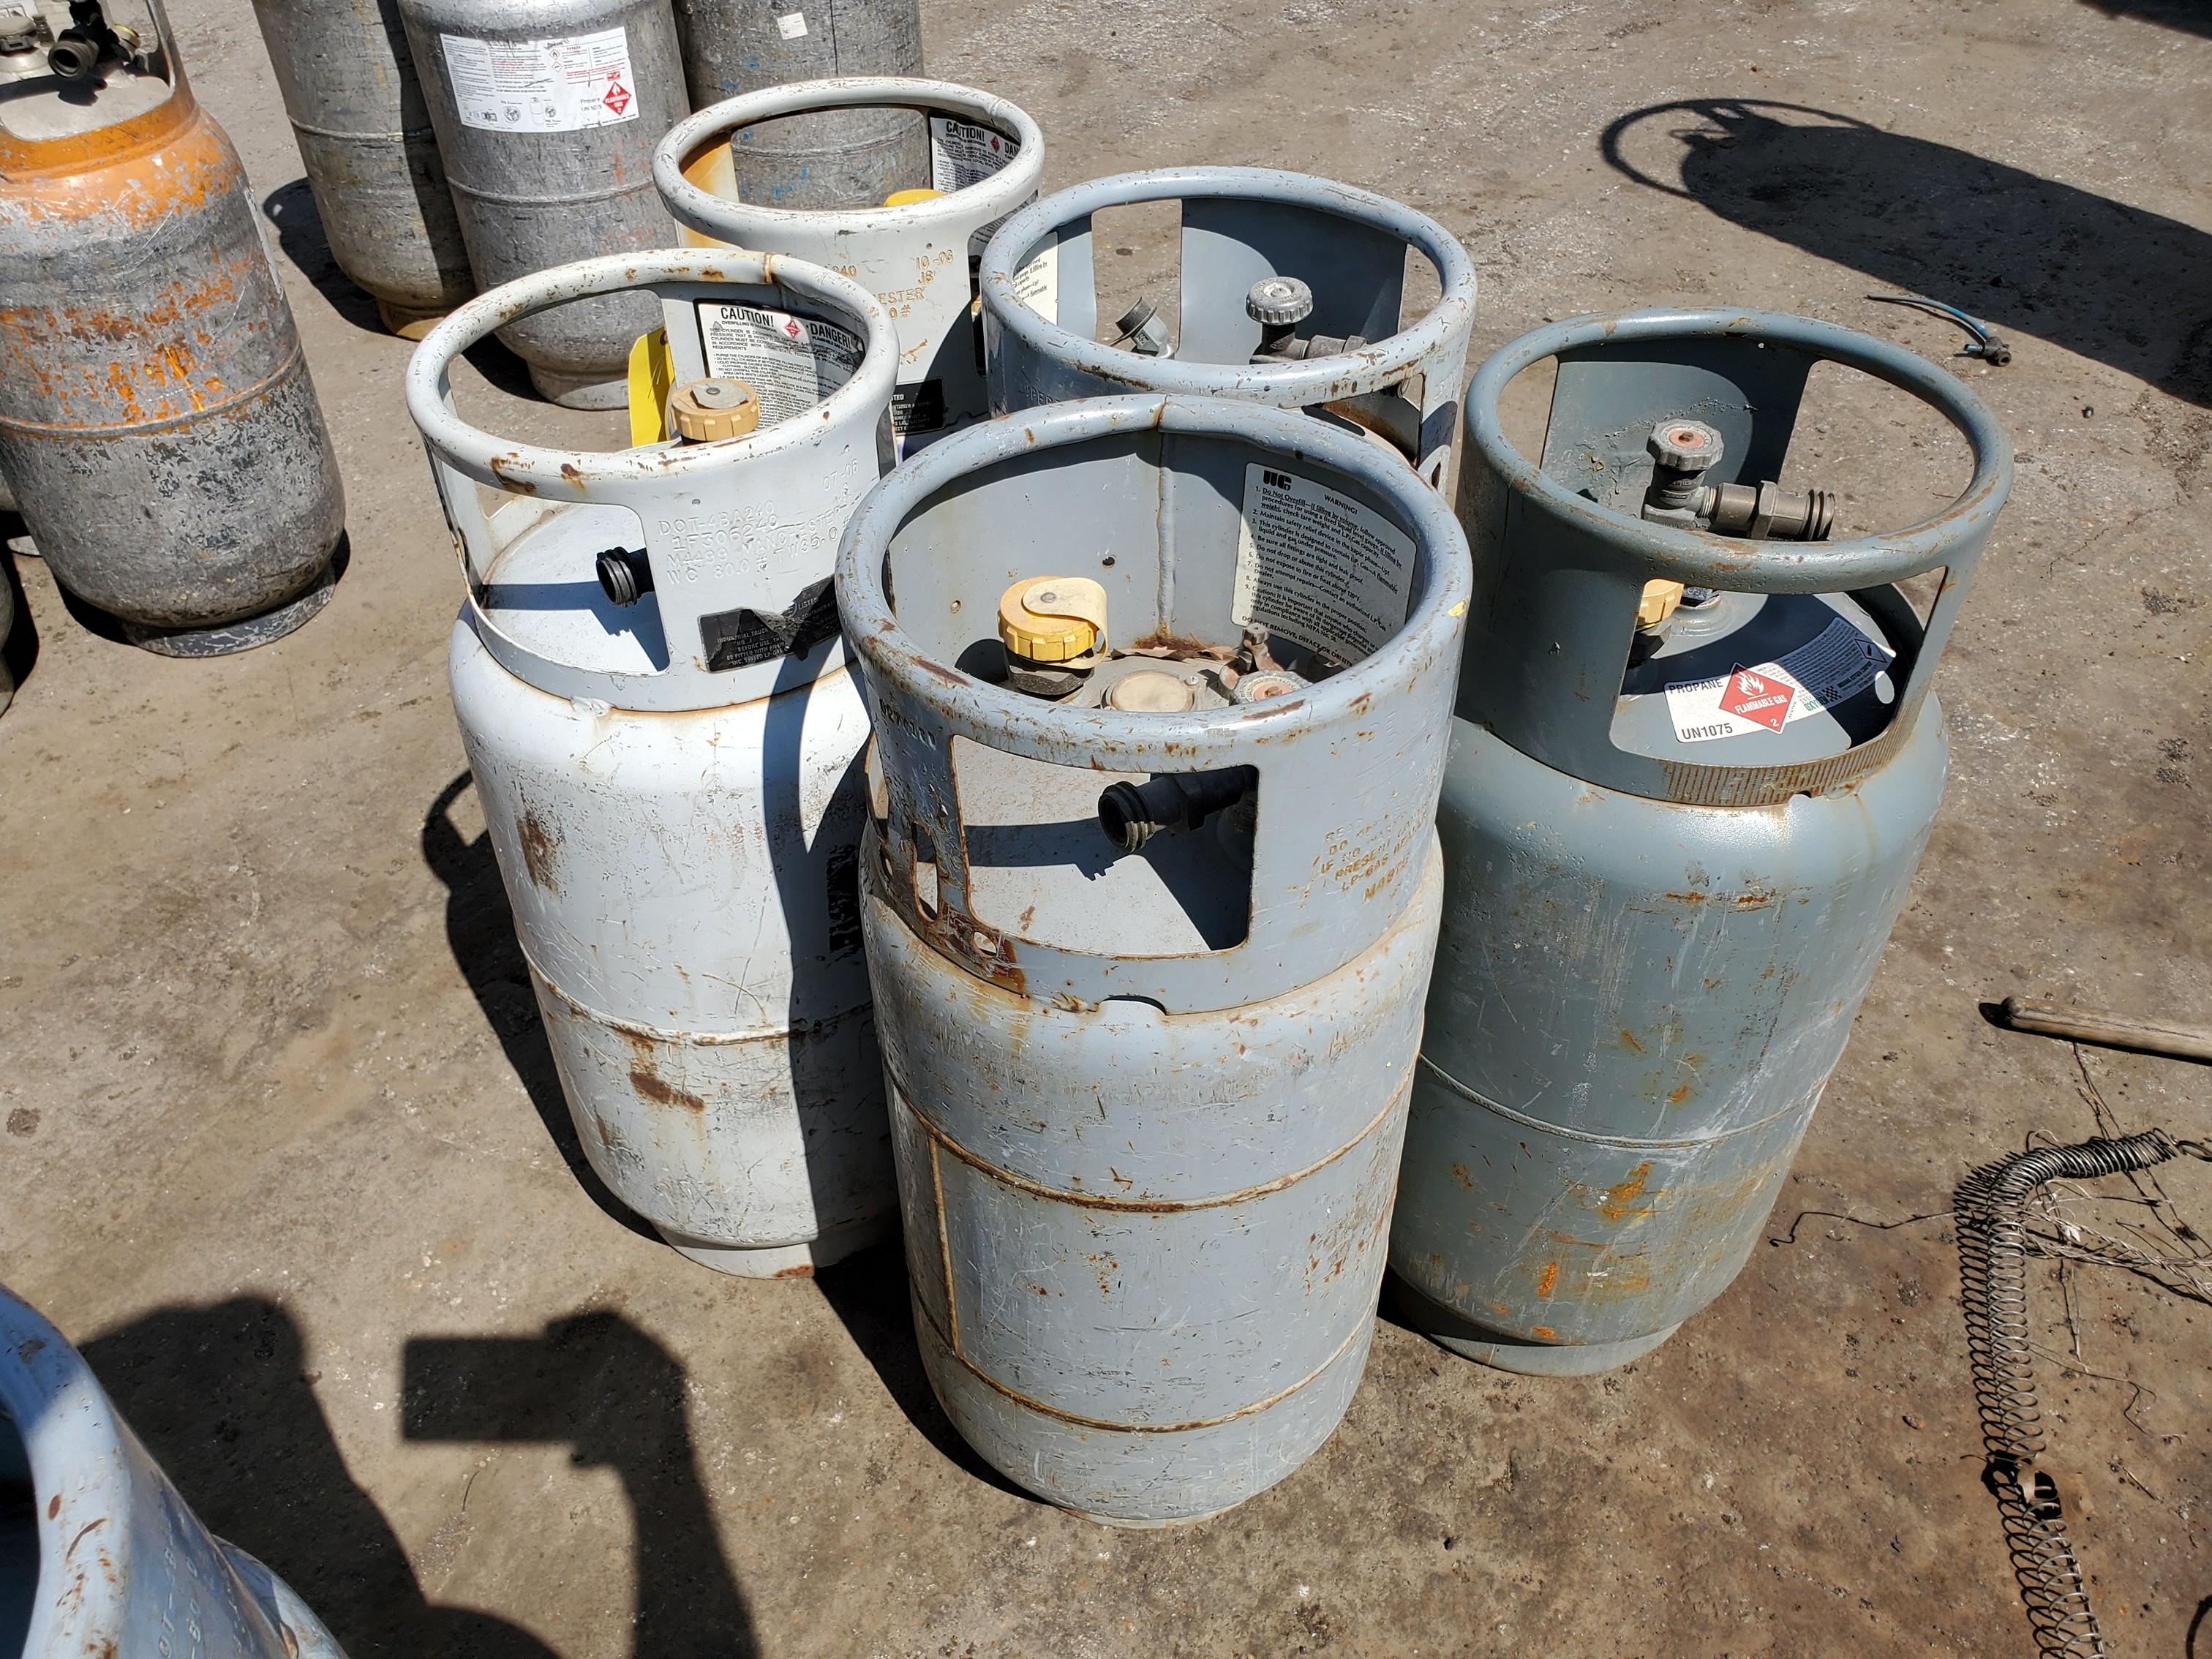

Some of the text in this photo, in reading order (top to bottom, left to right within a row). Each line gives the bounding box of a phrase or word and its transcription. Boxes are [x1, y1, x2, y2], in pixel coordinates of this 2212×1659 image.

[946, 121, 985, 142] CAUTION!
[721, 307, 774, 327] CAUTION!
[810, 323, 851, 350] DANGER!
[1324, 494, 1358, 515] WARNING!
[1260, 511, 1350, 550] Maintain safety relief device the
[1262, 496, 1293, 509] procedures
[1304, 508, 1319, 519] using
[1323, 516, 1337, 526] fixed
[1337, 521, 1352, 533] liquid
[1353, 529, 1364, 541] level
[1273, 490, 1283, 498] Not
[1316, 505, 1331, 517] filling
[1360, 527, 1375, 539] follow
[1375, 538, 1396, 554] approved
[1258, 526, 1275, 535] liquid
[1298, 539, 1314, 549] under
[1314, 546, 1337, 560] pressure.
[1260, 519, 1350, 560] This cylinder designed contain
[1283, 508, 1299, 518] check
[1312, 519, 1330, 530] weight
[1361, 543, 1380, 559] capacity.
[1254, 568, 1274, 579] Dealer.
[1276, 560, 1295, 571] expose
[1302, 569, 1312, 577] fire
[1320, 576, 1331, 585] heat
[1277, 550, 1291, 560] drop
[1298, 559, 1314, 568] abuse
[1315, 565, 1325, 573] this
[1325, 570, 1346, 584] cylinder.
[1287, 543, 1305, 555] fittings
[1315, 555, 1328, 565] tight
[1328, 562, 1338, 570] and
[1339, 565, 1349, 576] leak
[1350, 573, 1363, 585] proof.
[1253, 578, 1272, 587] Always
[1283, 587, 1293, 595] this
[1294, 591, 1315, 603] cylinder
[1322, 602, 1330, 611] the
[1331, 608, 1347, 620] proper
[1275, 569, 1295, 580] attempt
[1346, 601, 1370, 619] authorized
[1250, 604, 1329, 639] regulations including No.
[1251, 598, 1313, 624] only compliance with
[1252, 586, 1353, 633] Caution: important that anyone who
[1262, 596, 1284, 606] cylinder
[1293, 606, 1309, 616] aware
[1323, 619, 1347, 636] dangerous
[717, 628, 769, 644] INDUSTRIAL TRUCK
[738, 642, 759, 652] BEFORE
[1269, 624, 1321, 649] REMOVE, DEFACE
[734, 650, 753, 659] FITTED
[754, 647, 768, 655] WITH
[1669, 680, 1724, 694] PROPANE
[1734, 698, 1774, 714] FLAMMABLE
[1773, 694, 1788, 704] GAS
[1682, 723, 1734, 740] UN1075
[1770, 718, 1779, 727] 2
